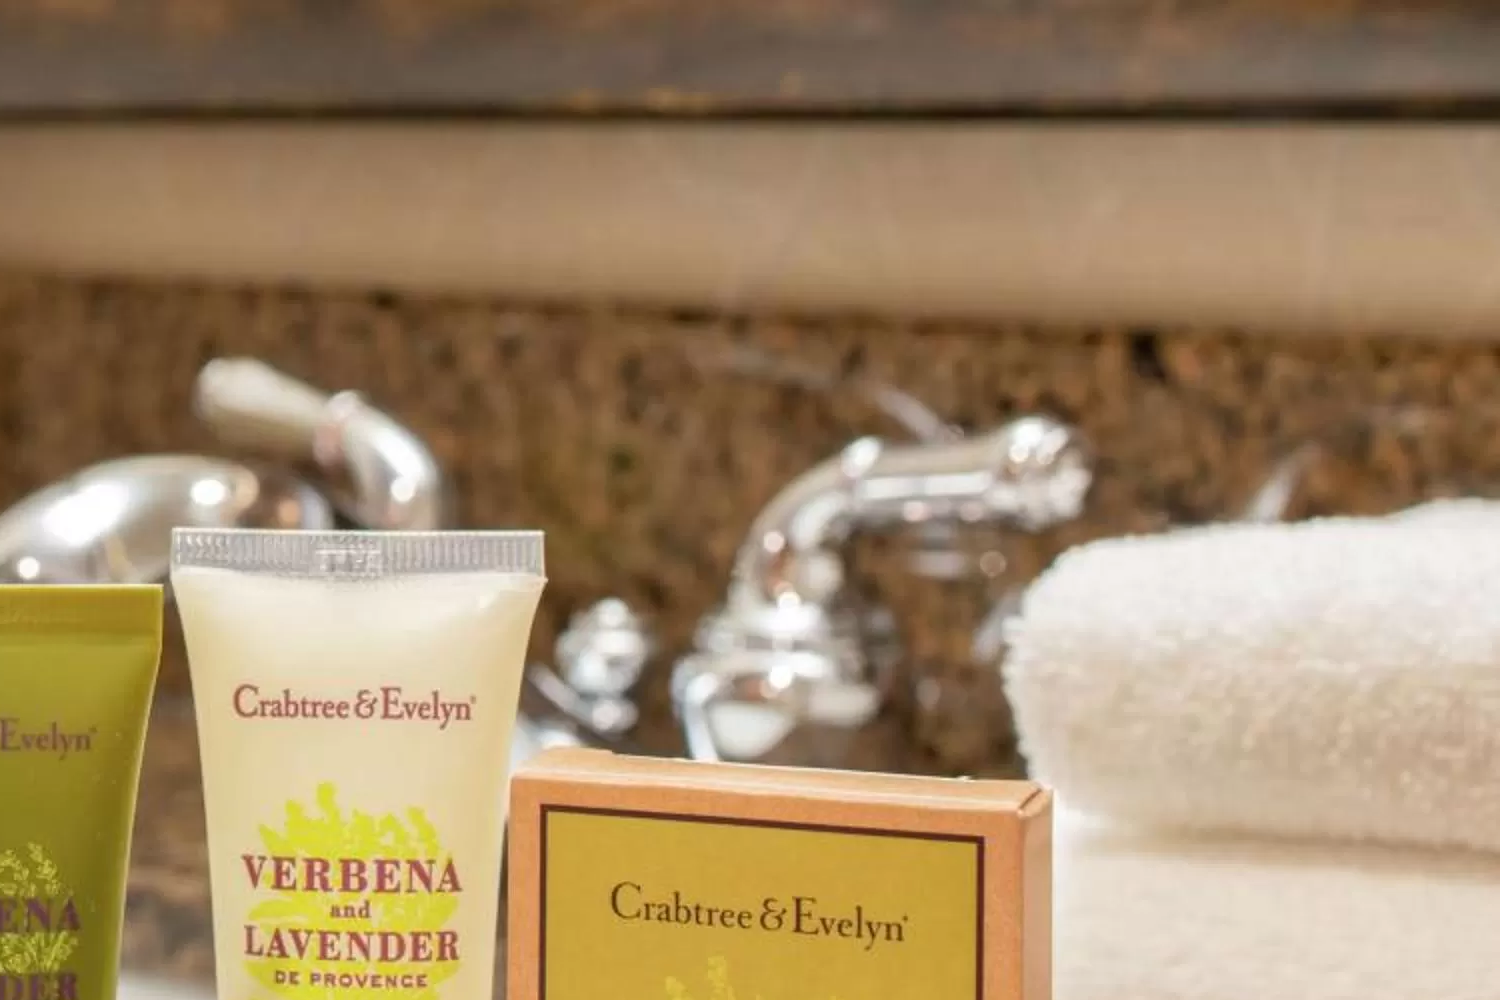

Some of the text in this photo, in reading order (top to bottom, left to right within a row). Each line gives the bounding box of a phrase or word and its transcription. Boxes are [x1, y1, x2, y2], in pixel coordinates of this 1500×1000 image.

[233, 684, 350, 718] Crabtree
[354, 689, 378, 719] &
[241, 854, 463, 893] VERBENA
[329, 900, 372, 919] and
[611, 881, 753, 929] Crabtree
[759, 898, 787, 931] &
[243, 924, 460, 963] LAVENDER
[275, 970, 428, 988] DE PROVENCE
